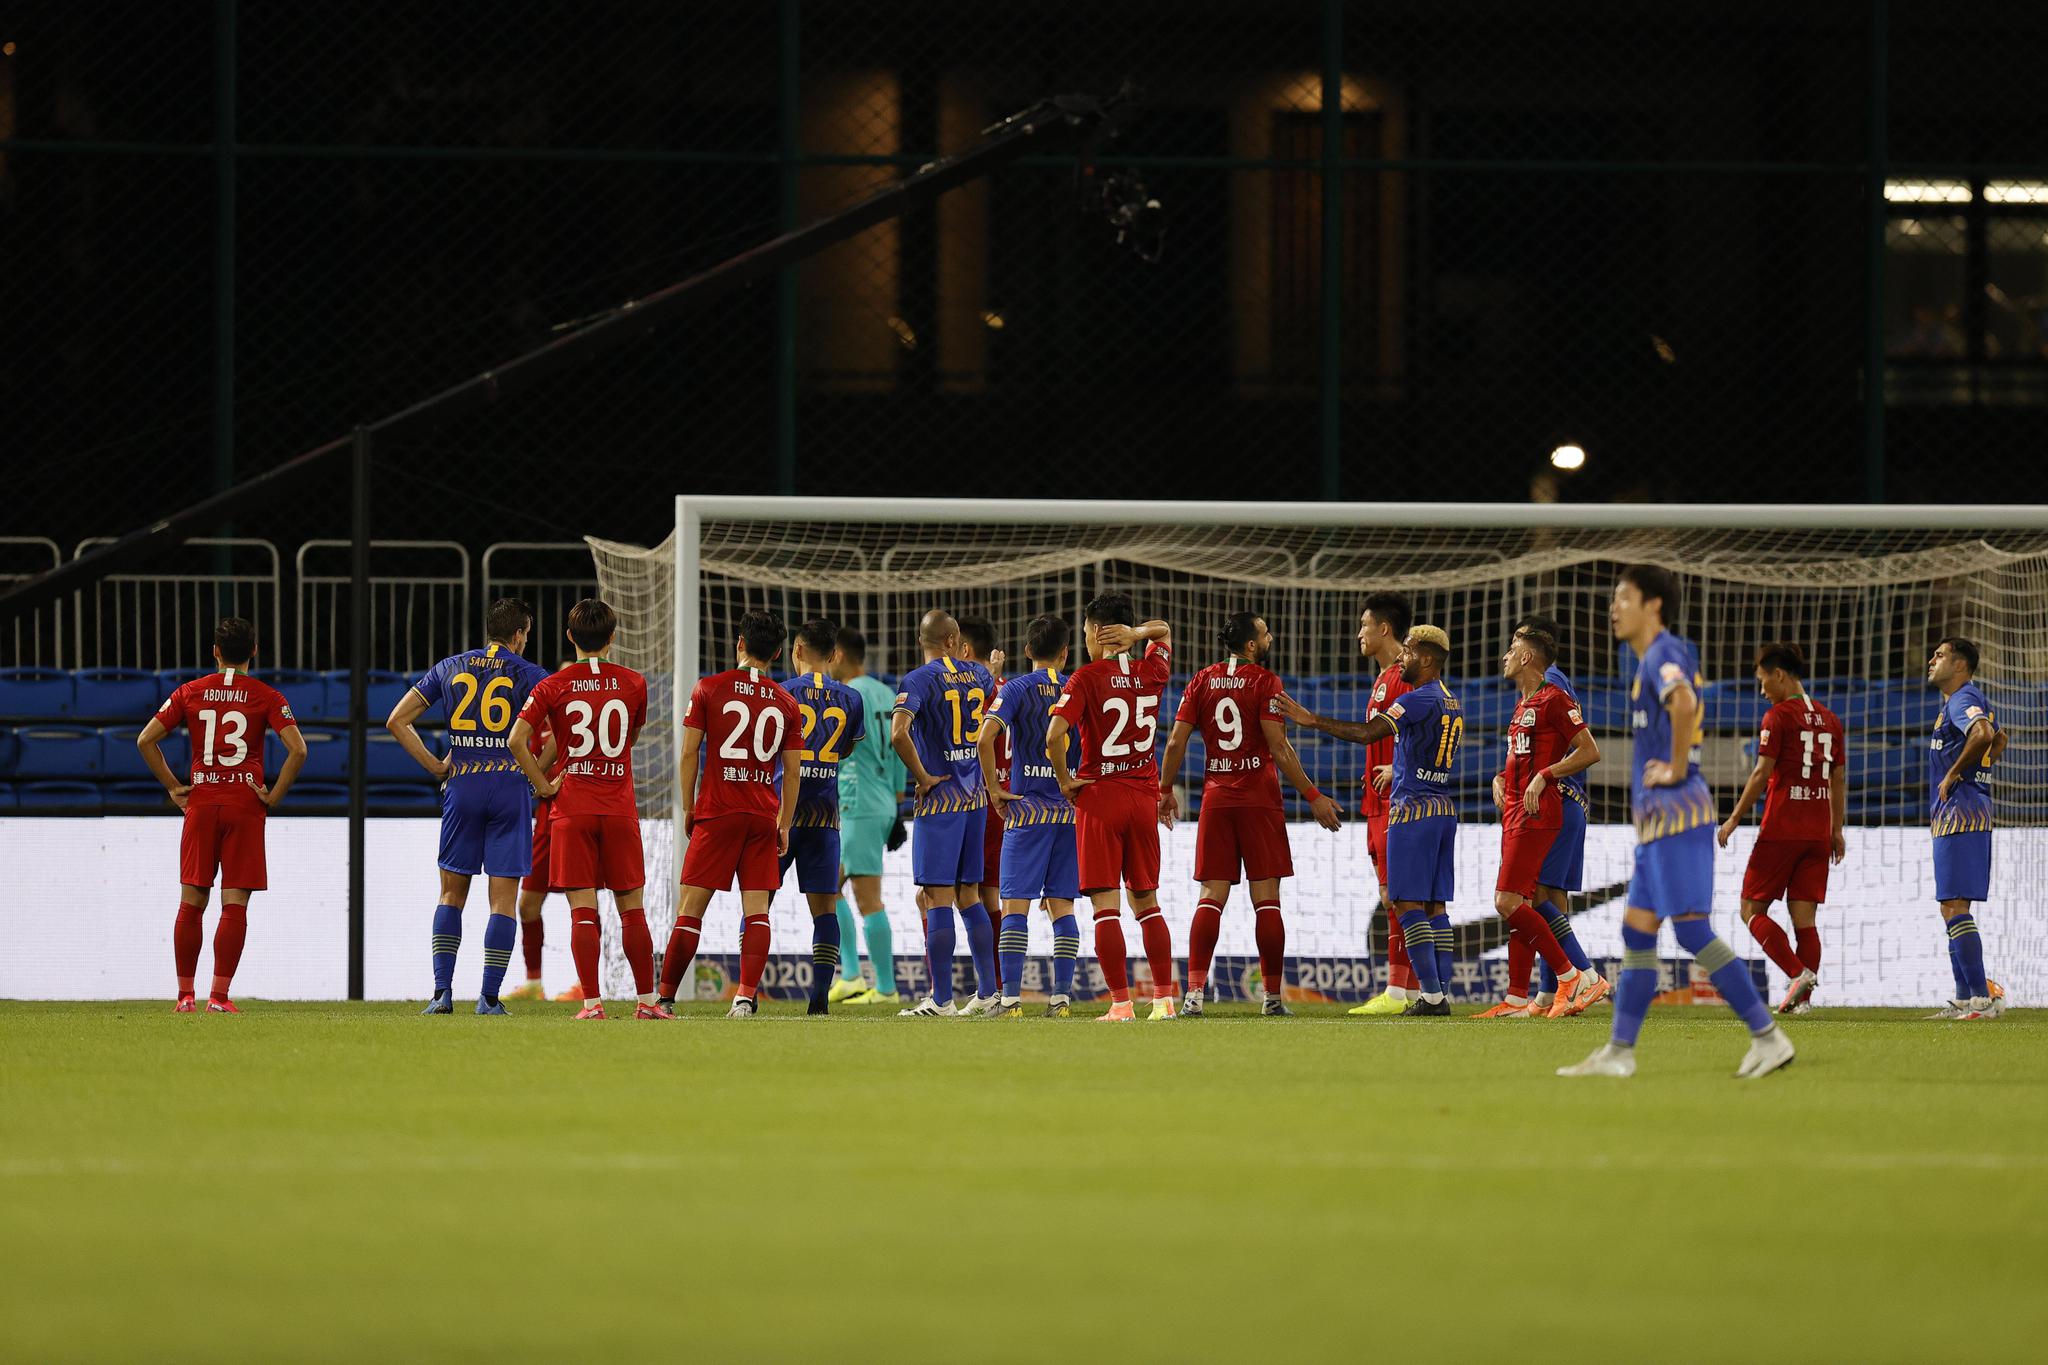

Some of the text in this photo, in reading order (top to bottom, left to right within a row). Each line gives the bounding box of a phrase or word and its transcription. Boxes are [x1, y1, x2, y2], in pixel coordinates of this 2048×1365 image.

[469, 656, 503, 669] SANTINI
[203, 689, 248, 703] ABDUWALI
[571, 677, 620, 692] ZHONG J.B.
[734, 681, 776, 700] FENG B.X.
[806, 688, 820, 700] WU
[1037, 684, 1056, 697] TIAN
[1134, 677, 1144, 689] H.
[450, 672, 514, 732] 26
[944, 687, 985, 745] 13
[199, 709, 248, 767] 13
[565, 699, 629, 758] 30
[720, 700, 784, 762] 20
[799, 704, 847, 763] 22
[1101, 695, 1158, 756] 25
[1215, 697, 1243, 750] 9
[450, 735, 509, 748] SAMSUN
[944, 748, 977, 762] SAMSU
[1435, 714, 1463, 769] 10
[1800, 730, 1834, 780] 11
[799, 766, 836, 779] MSUNG
